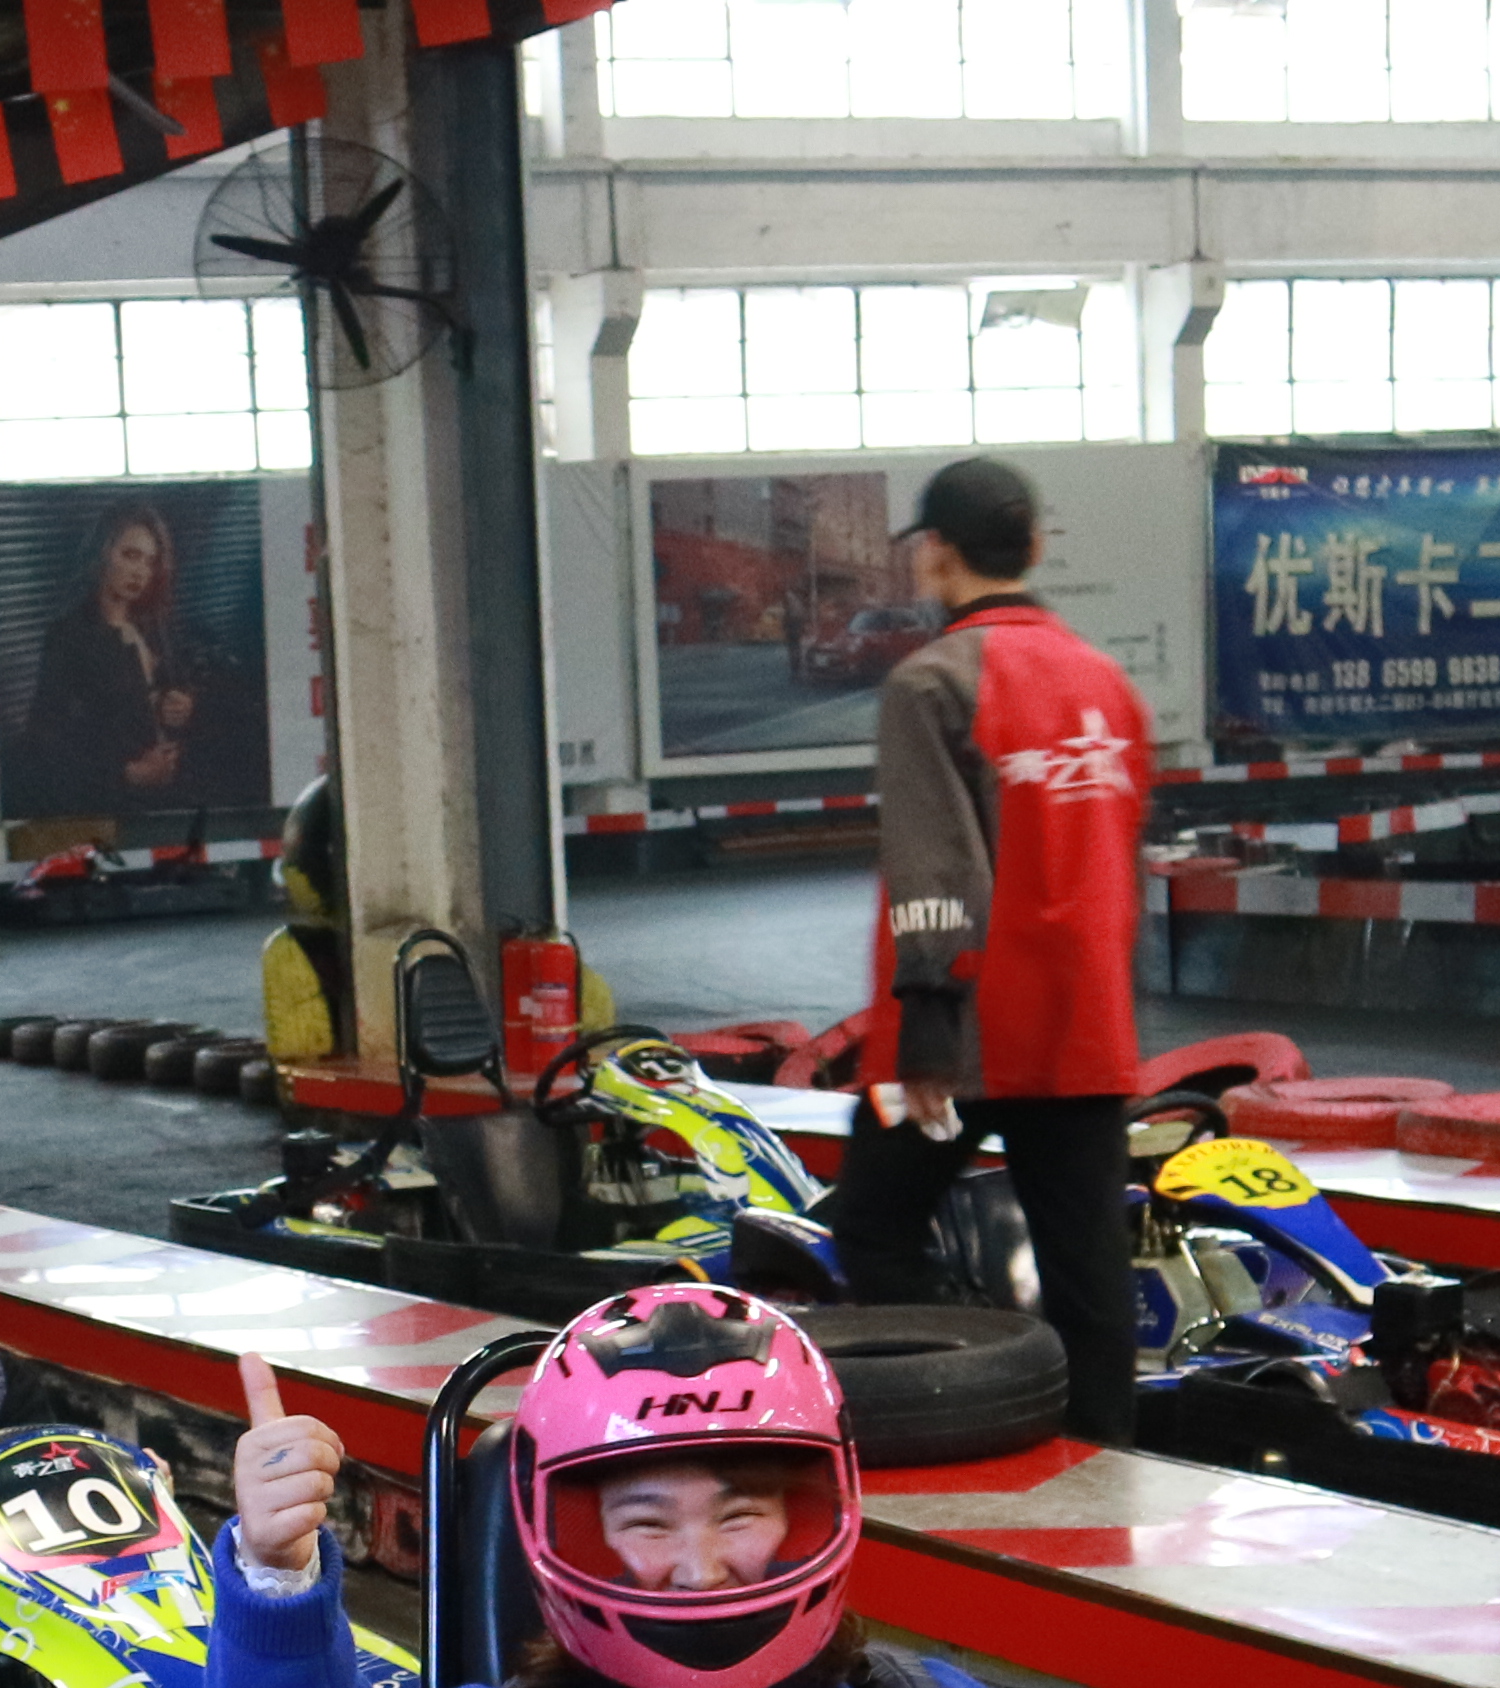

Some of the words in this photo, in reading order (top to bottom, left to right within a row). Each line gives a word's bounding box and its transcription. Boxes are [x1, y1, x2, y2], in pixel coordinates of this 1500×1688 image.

[1219, 1167, 1298, 1200] 18
[636, 1389, 755, 1421] HNJ
[1, 1477, 143, 1552] 10
